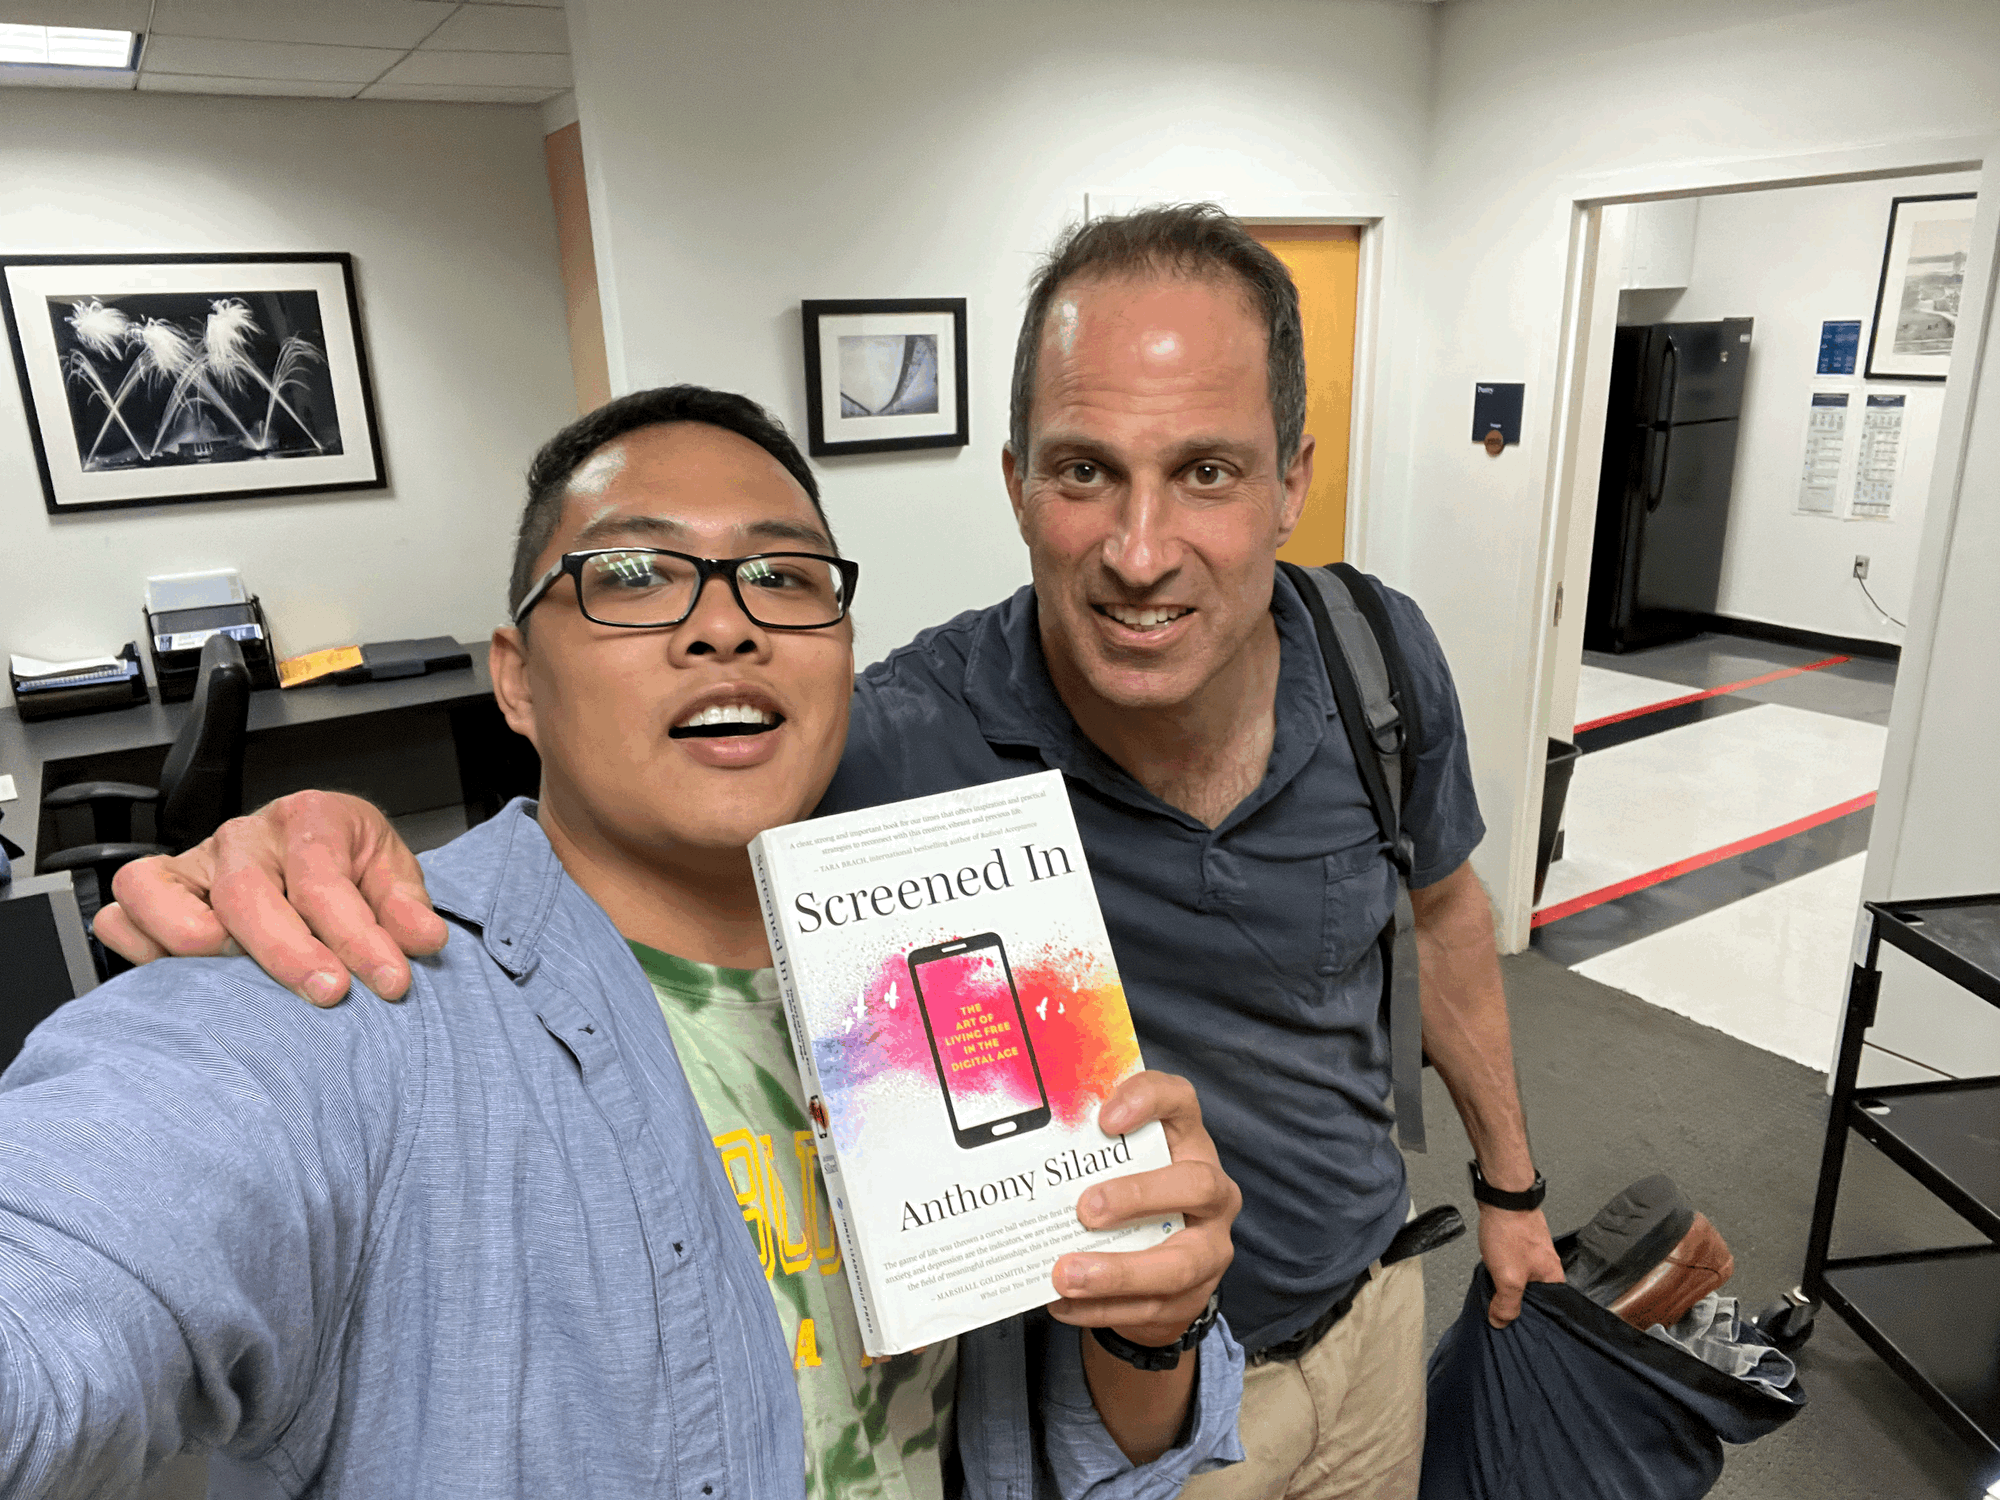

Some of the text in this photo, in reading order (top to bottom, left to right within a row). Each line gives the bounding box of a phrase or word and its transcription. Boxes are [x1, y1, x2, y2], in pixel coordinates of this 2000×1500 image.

[813, 835, 834, 844] strong
[835, 831, 848, 840] and
[849, 825, 882, 837] important
[882, 821, 898, 830] book
[922, 814, 940, 822] times
[940, 810, 954, 818] that
[954, 807, 972, 815] offers
[973, 800, 1006, 811] inspiration
[1007, 795, 1019, 804] and
[1020, 790, 1046, 803] practical
[821, 844, 852, 854] strategies
[860, 835, 892, 846] reconnect
[892, 831, 908, 840] with
[908, 829, 921, 837] this
[971, 815, 983, 824] and
[984, 811, 1010, 822] precious
[819, 862, 840, 872] TARA
[868, 847, 912, 862] international
[950, 836, 970, 845] author
[795, 844, 1076, 934] Screened In
[956, 1013, 994, 1031] ART OF
[960, 1003, 982, 1016] THE
[945, 1021, 1011, 1046] LIVING FREE
[964, 1038, 1000, 1055] IN THE
[951, 1046, 1018, 1072] DIGITAL AGE
[900, 1133, 1133, 1232] Anthony Silard
[883, 1261, 897, 1270] The
[898, 1255, 917, 1267] game
[926, 1247, 938, 1256] life
[938, 1244, 952, 1252] was
[953, 1236, 978, 1248] thrown
[984, 1227, 1004, 1237] curve
[1003, 1222, 1017, 1231] ball
[1018, 1217, 1036, 1226] when
[907, 1282, 919, 1290] the
[920, 1275, 936, 1286] field
[945, 1259, 984, 1279] meaningful
[1028, 1242, 1042, 1250] this
[1048, 1236, 1060, 1244] the
[1060, 1232, 1073, 1240] one
[912, 1264, 926, 1275] and
[926, 1254, 963, 1270] depression
[964, 1250, 975, 1258] are
[976, 1246, 988, 1254] the
[1045, 1220, 1070, 1233] striking
[936, 1281, 978, 1300] MARSHALL
